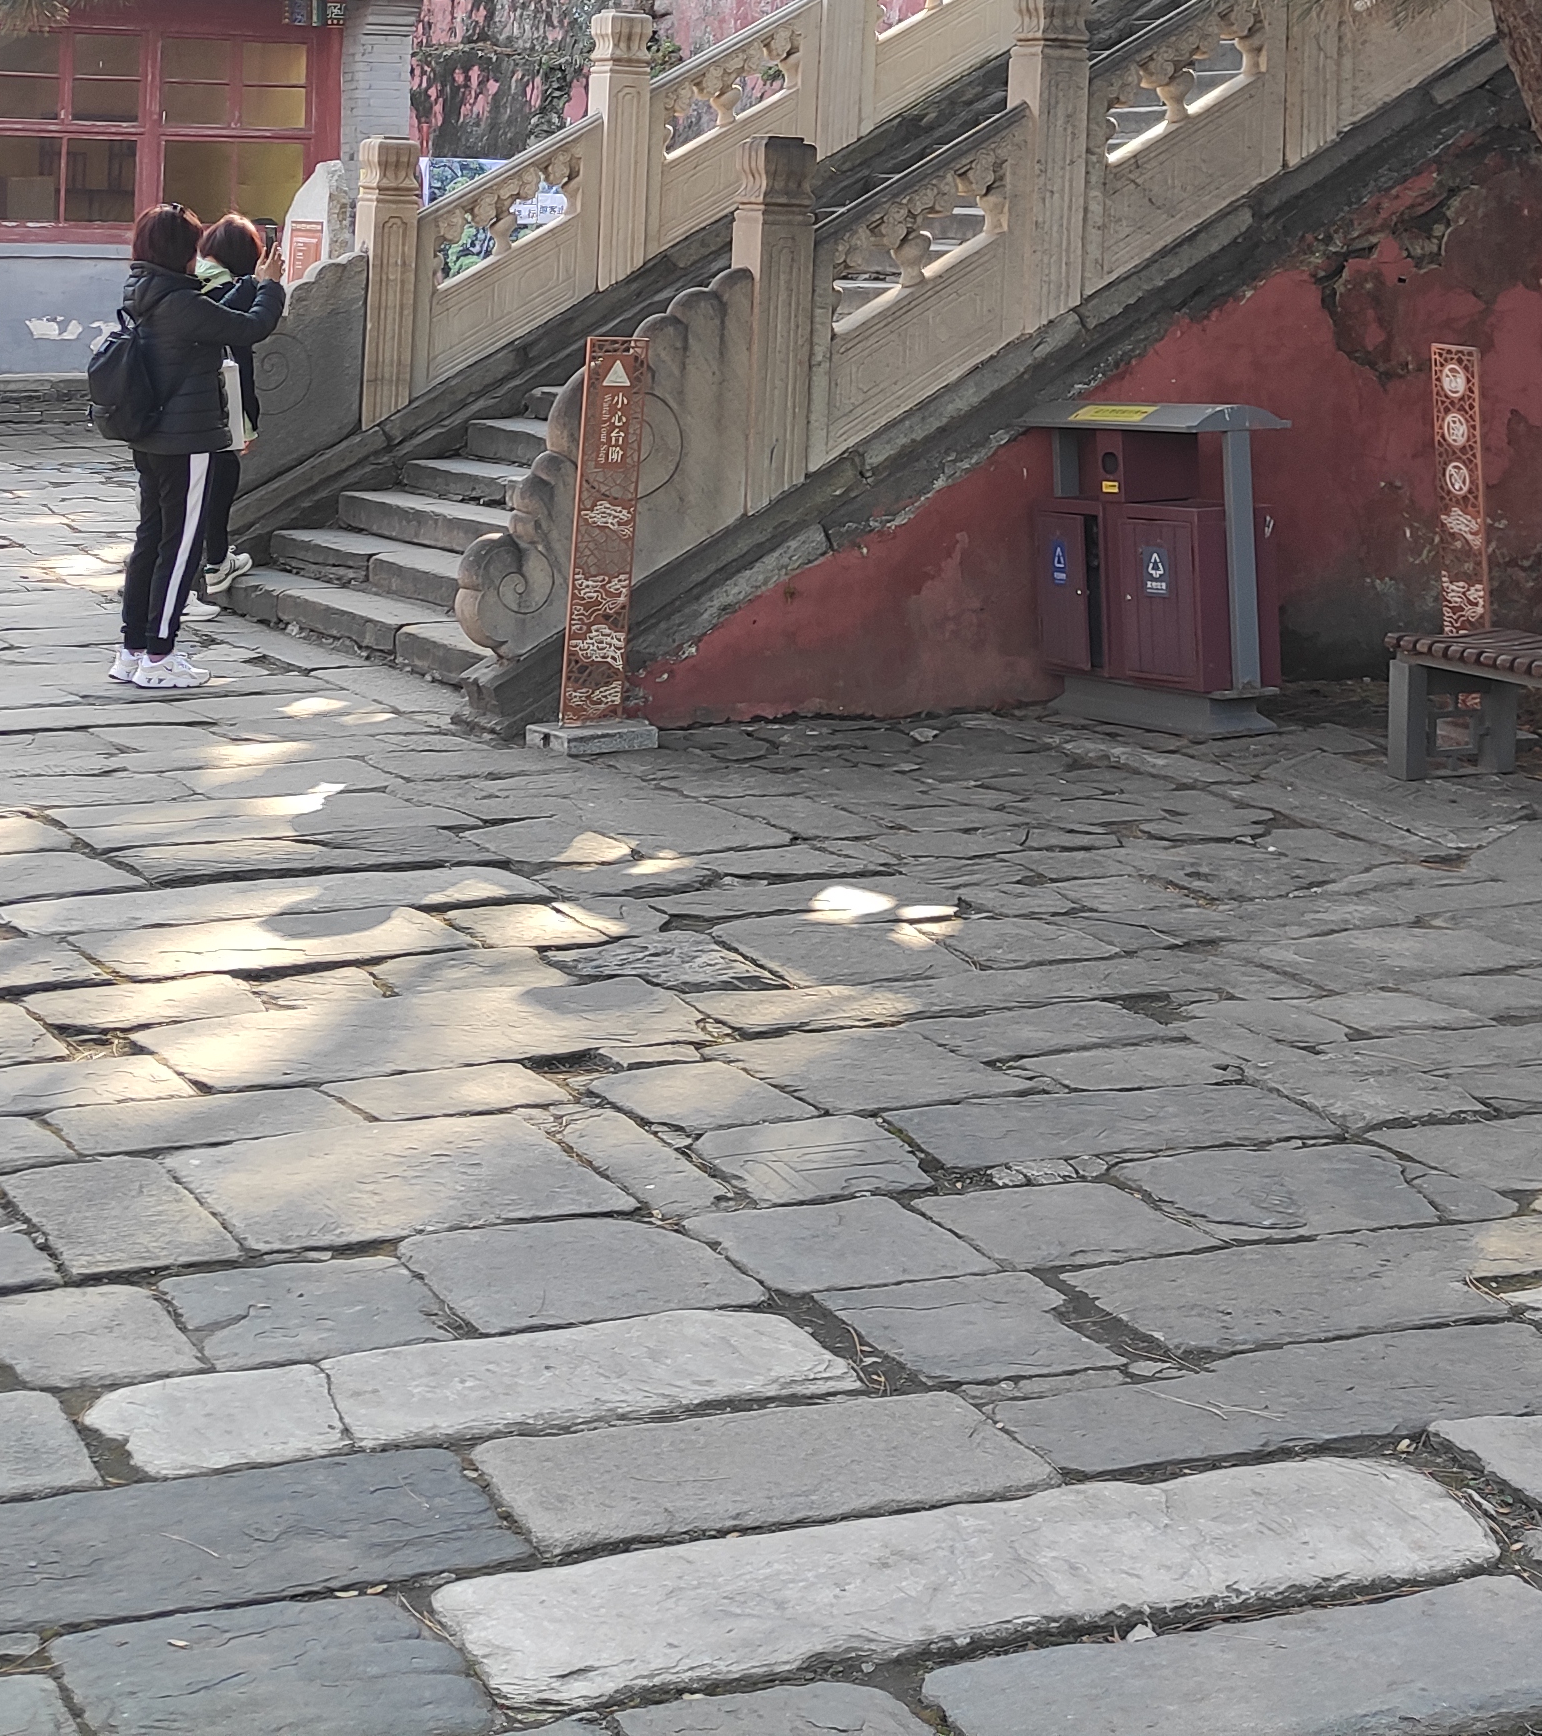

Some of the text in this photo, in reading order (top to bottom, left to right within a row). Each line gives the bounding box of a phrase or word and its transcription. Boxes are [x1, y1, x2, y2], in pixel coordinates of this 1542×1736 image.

[597, 394, 612, 464] Watch Your Step
[608, 392, 628, 463] 小心台阶
